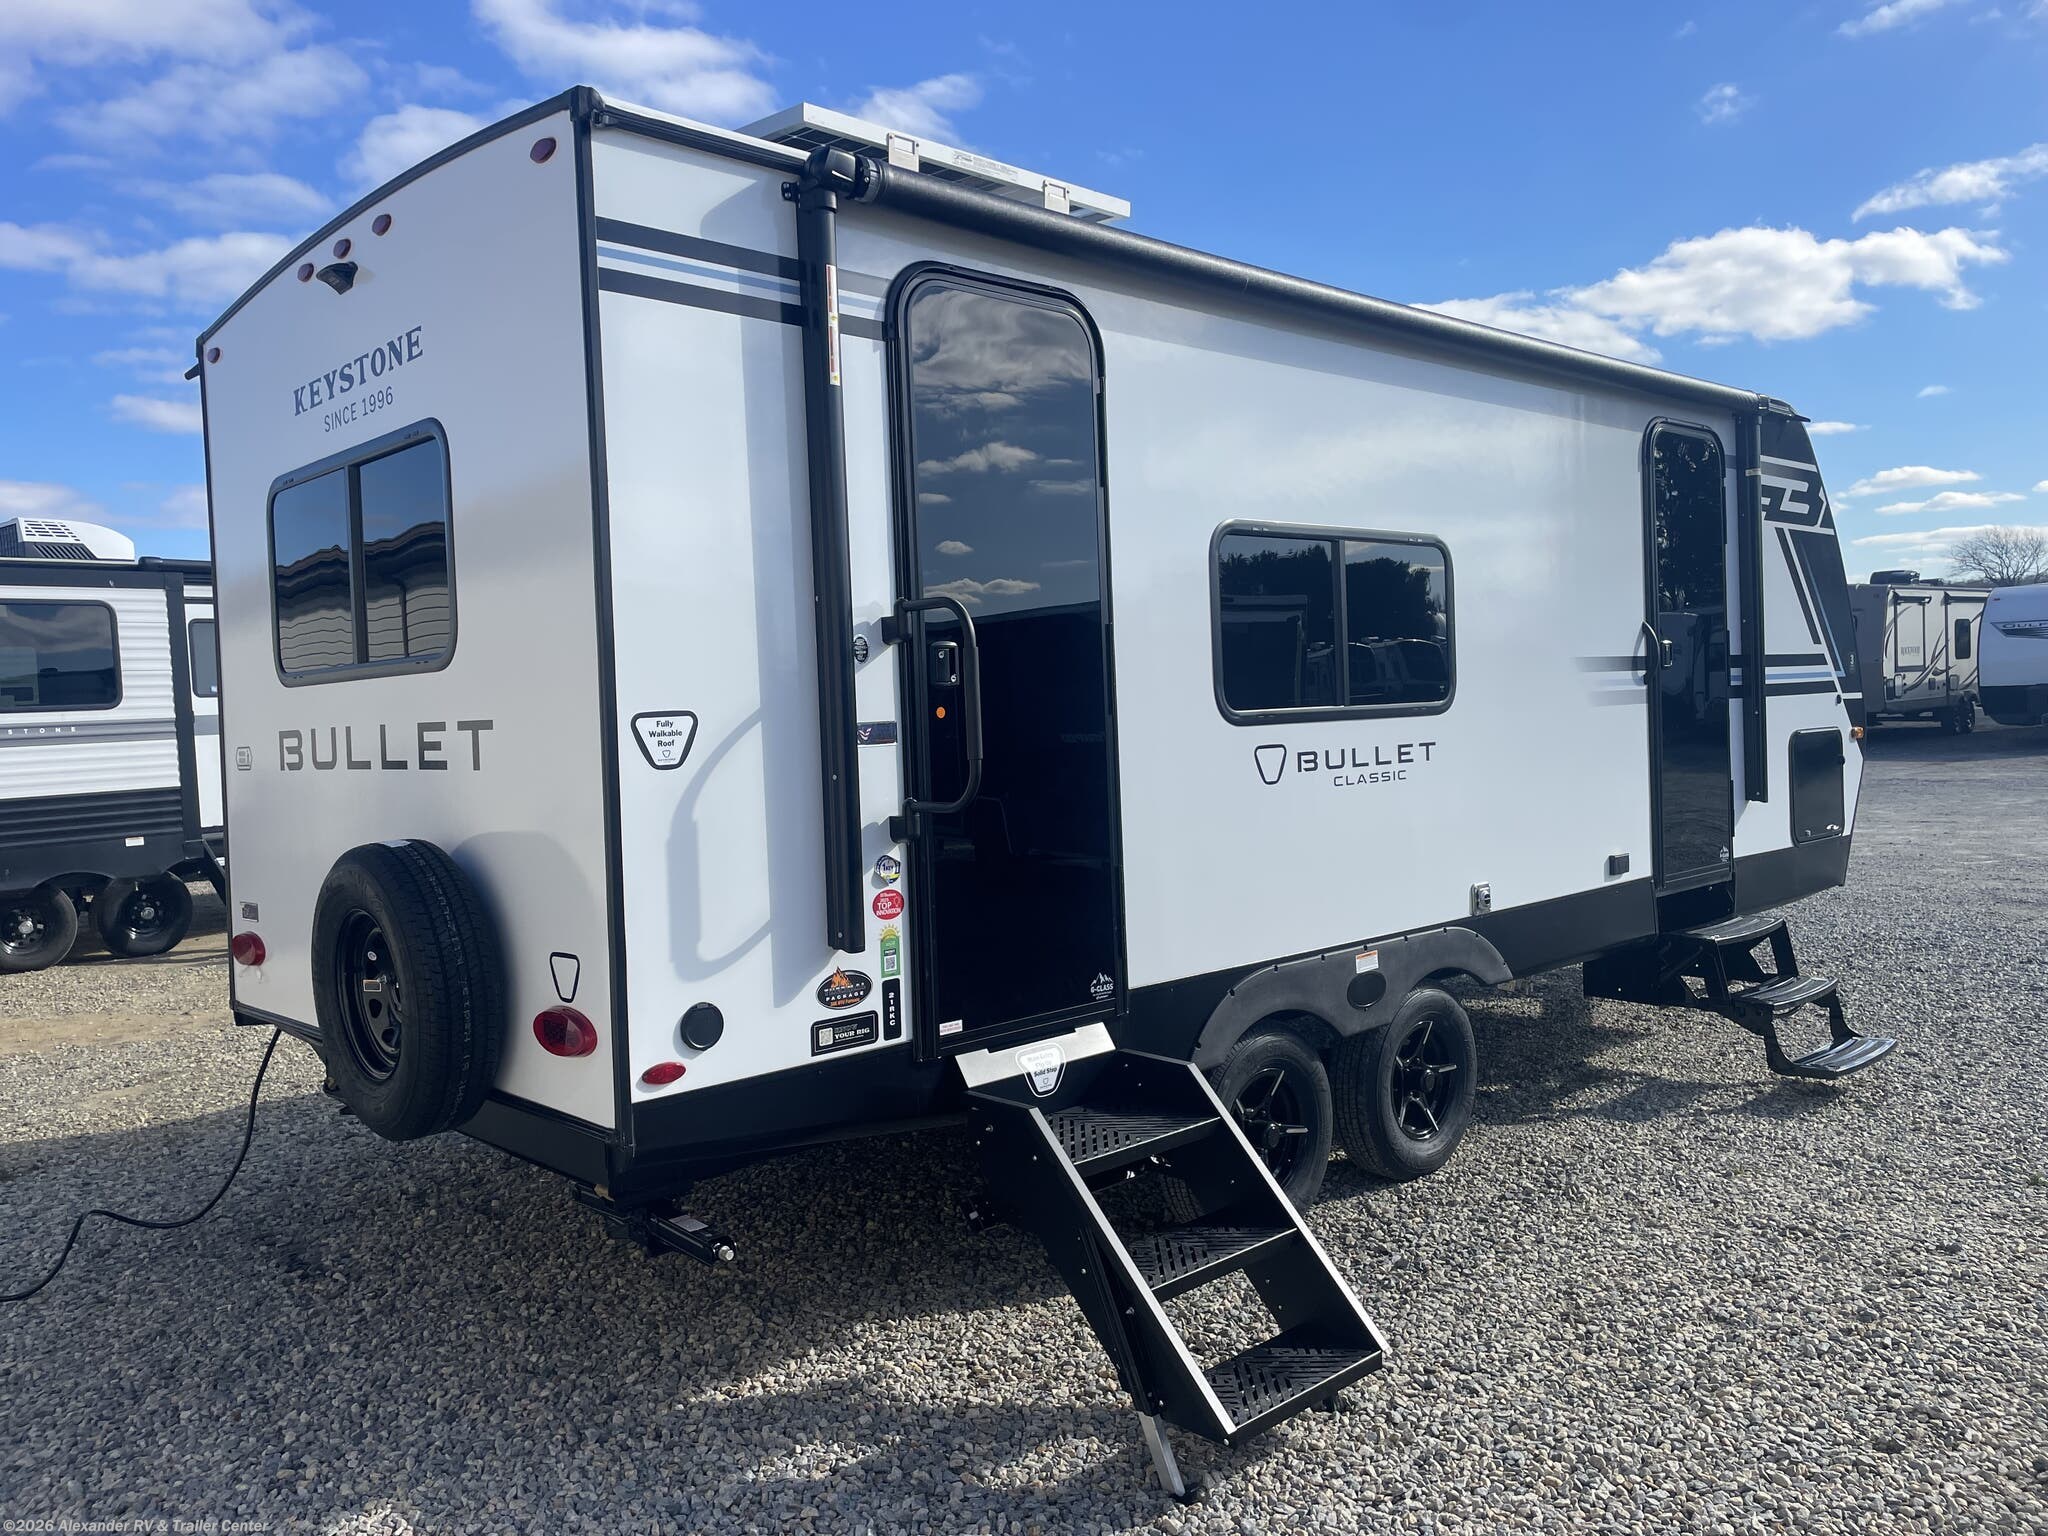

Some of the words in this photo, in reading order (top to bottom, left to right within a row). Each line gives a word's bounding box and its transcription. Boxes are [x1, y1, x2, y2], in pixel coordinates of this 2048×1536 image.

[293, 325, 423, 416] KEYSTONE
[324, 402, 358, 432] SINCE
[362, 385, 393, 416] 1996
[656, 720, 674, 728] Fully
[648, 729, 683, 738] Walkable
[279, 720, 494, 771] BULLET
[657, 739, 675, 748] Roof
[1297, 742, 1436, 773] BULLET
[1333, 770, 1407, 787] CLASSIC
[877, 901, 893, 910] TOP
[825, 990, 865, 1002] PACKAGE
[834, 1030, 855, 1040] YOUR
[856, 1026, 870, 1035] RIG
[1034, 1068, 1046, 1077] Solid
[1046, 1066, 1058, 1074] Step
